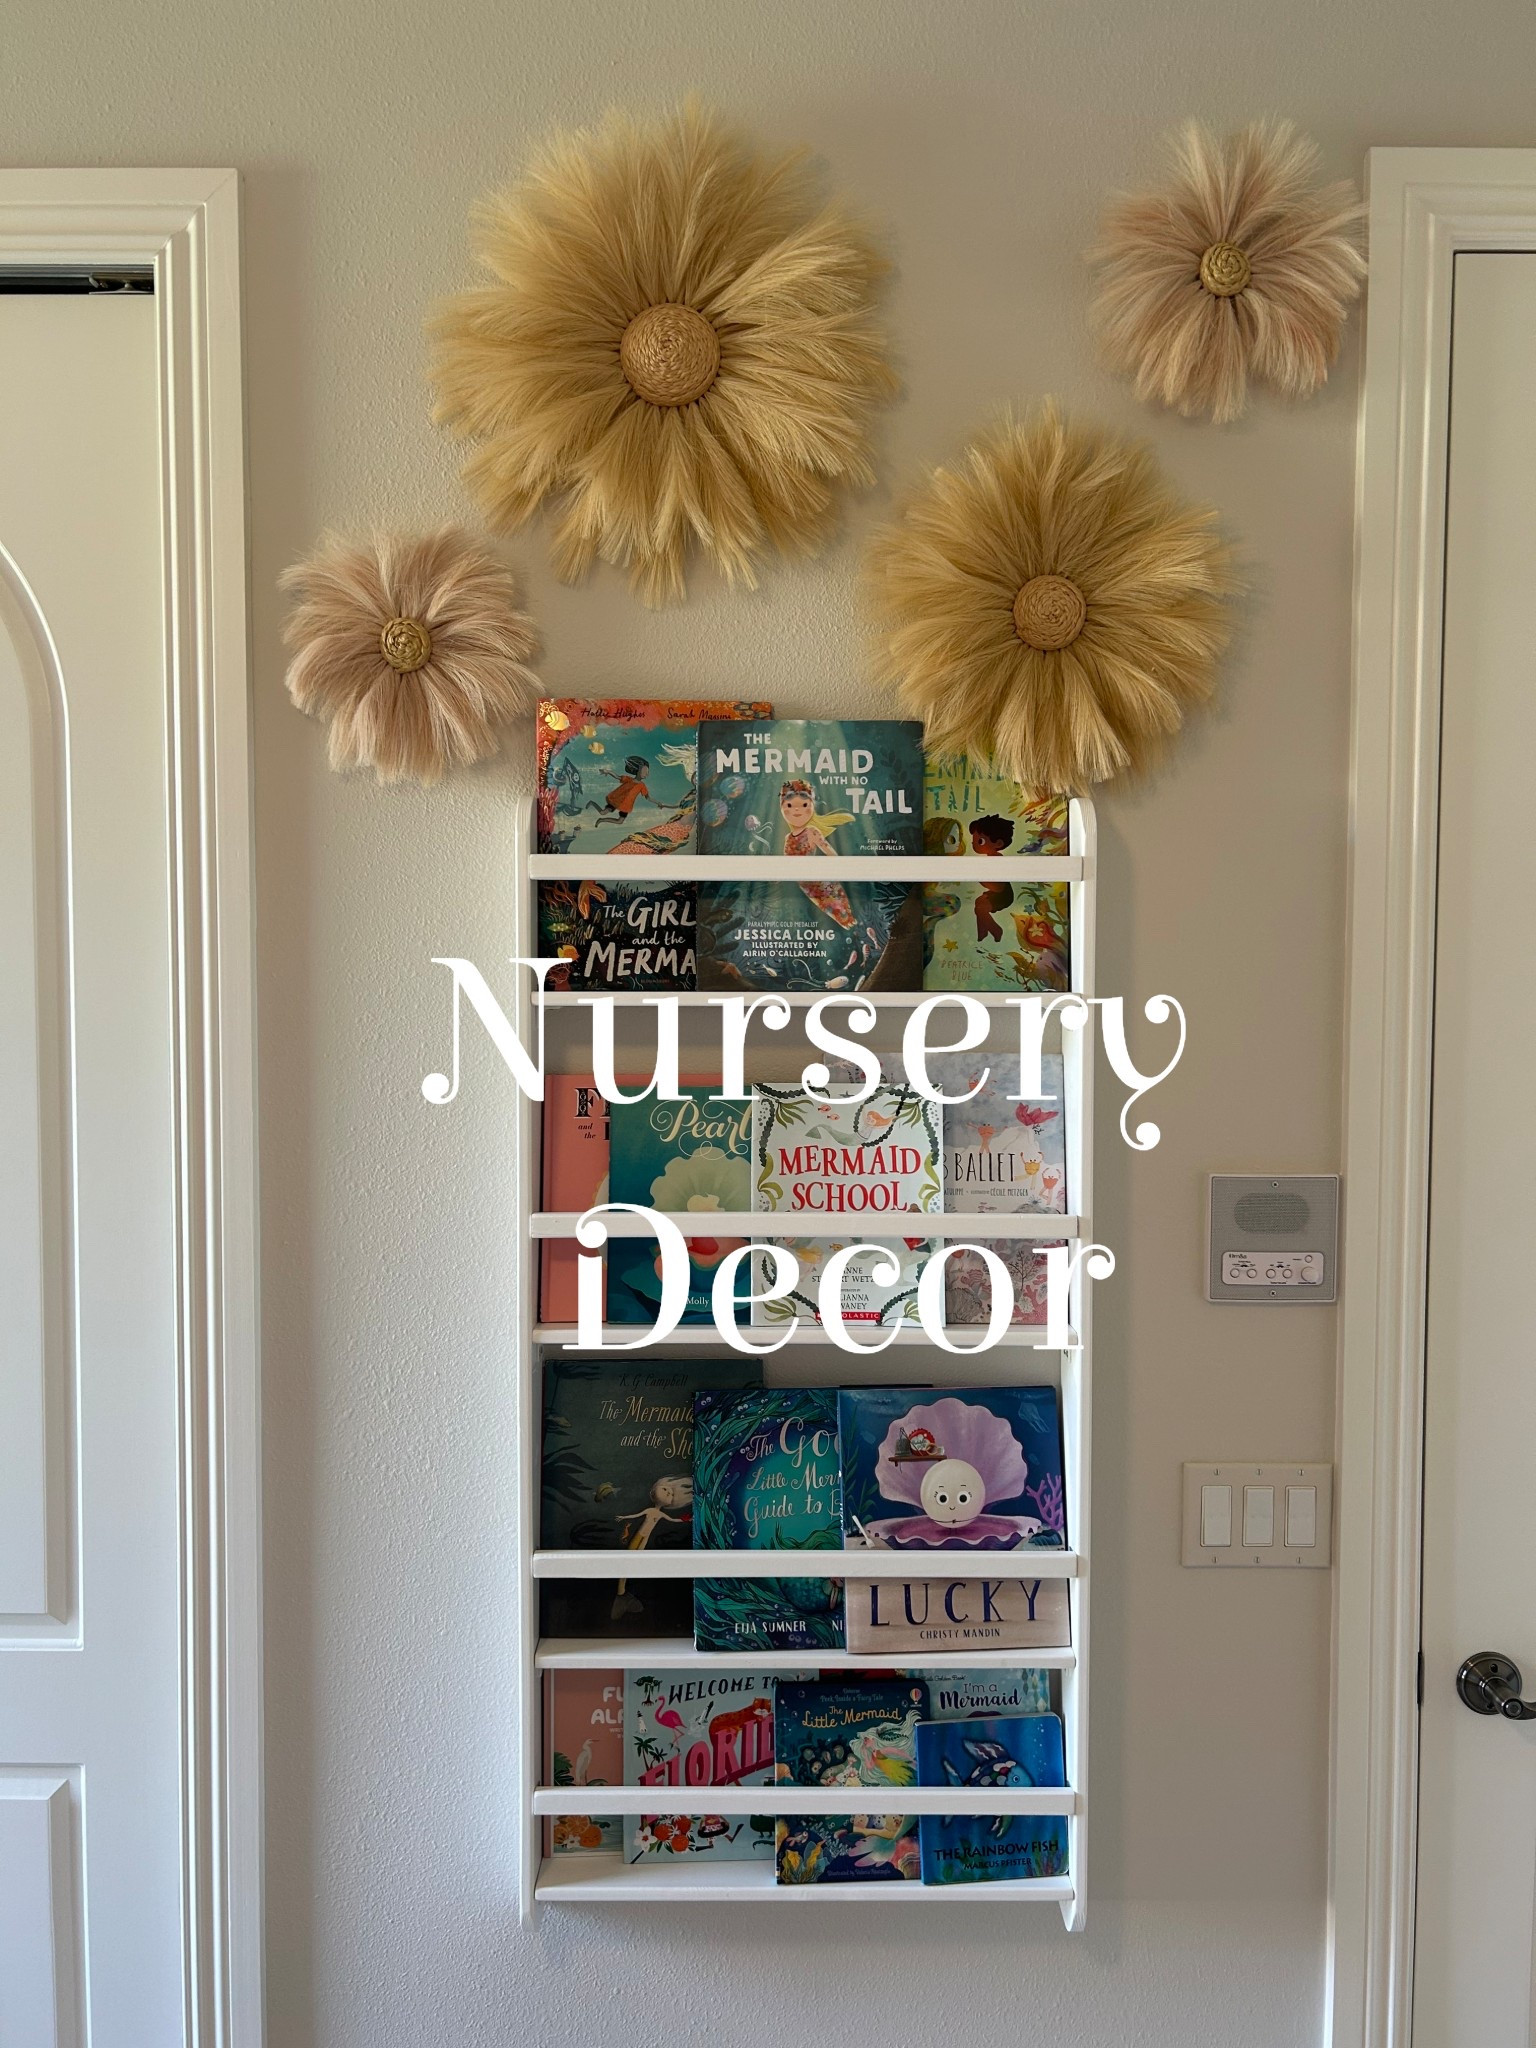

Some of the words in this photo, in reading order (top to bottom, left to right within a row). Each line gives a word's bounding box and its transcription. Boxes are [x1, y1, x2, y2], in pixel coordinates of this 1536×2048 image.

[613, 707, 646, 721] Hughes
[667, 707, 695, 719] Sarah
[743, 733, 772, 745] THE
[716, 748, 874, 774] MERMAID
[819, 775, 848, 785] WITH
[852, 775, 868, 785] NO
[845, 787, 913, 815] TAIL
[926, 781, 986, 813] TAIL
[603, 905, 626, 919] The
[627, 896, 697, 934] GIRL
[631, 931, 660, 946] and
[664, 931, 686, 946] the
[734, 929, 792, 941] JESSICA
[796, 929, 836, 941] LONG
[743, 950, 767, 958] AIRIN
[769, 950, 828, 958] O'CALLAGHAN
[578, 1122, 593, 1130] and
[584, 1131, 597, 1139] the
[650, 1100, 752, 1157] Pearl
[778, 1145, 921, 1177] MERMAID
[954, 1152, 1016, 1182] BALLET
[792, 1181, 908, 1213] SCHOOL
[686, 1296, 710, 1308] Molly
[644, 1373, 689, 1389] Campbell
[600, 1399, 623, 1421] The
[620, 1429, 645, 1447] and
[643, 1428, 667, 1448] the
[746, 1431, 776, 1462] The
[746, 1467, 788, 1491] Little
[743, 1494, 795, 1539] Guide
[801, 1494, 824, 1515] to
[869, 1579, 1042, 1627] LUCKY
[735, 1622, 757, 1635] EIJA
[762, 1620, 807, 1633] SUMNER
[919, 1629, 960, 1640] CHRISTY
[963, 1627, 1001, 1639] MANDIN
[668, 1676, 756, 1706] WELCOME
[963, 1683, 985, 1694] I'm
[988, 1684, 998, 1692] a
[940, 1688, 1023, 1710] Mermaid
[802, 1710, 838, 1729] Little
[840, 1707, 903, 1726] Mermaid
[829, 1706, 844, 1715] The
[934, 1848, 961, 1861] THE
[962, 1842, 1030, 1858] RAINBOW
[1031, 1840, 1059, 1852] FISH
[964, 1860, 1000, 1871] MARCUS
[1001, 1858, 1032, 1867] PFISTER
